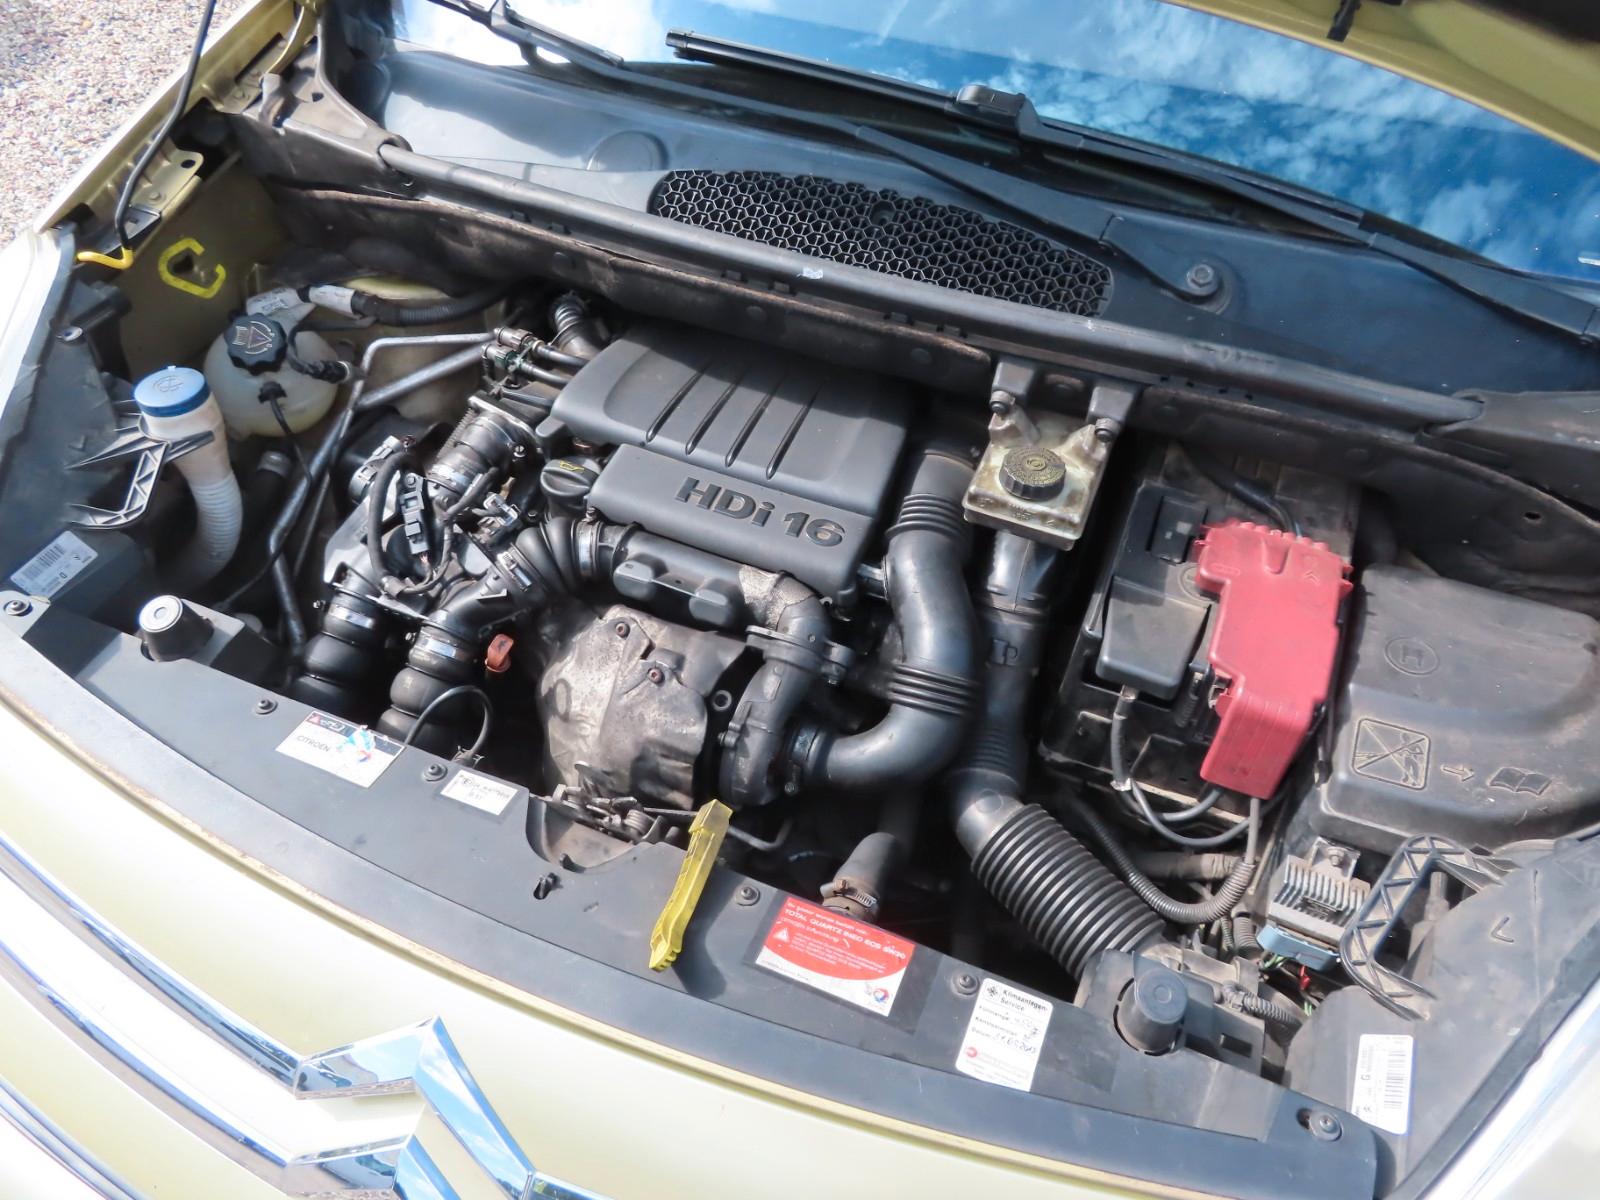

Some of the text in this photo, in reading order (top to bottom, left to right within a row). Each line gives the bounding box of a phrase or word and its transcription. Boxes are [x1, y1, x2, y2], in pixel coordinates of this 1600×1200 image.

[676, 476, 846, 547] HDi 16
[784, 908, 808, 922] TOTAL
[809, 918, 842, 934] QUARTZ
